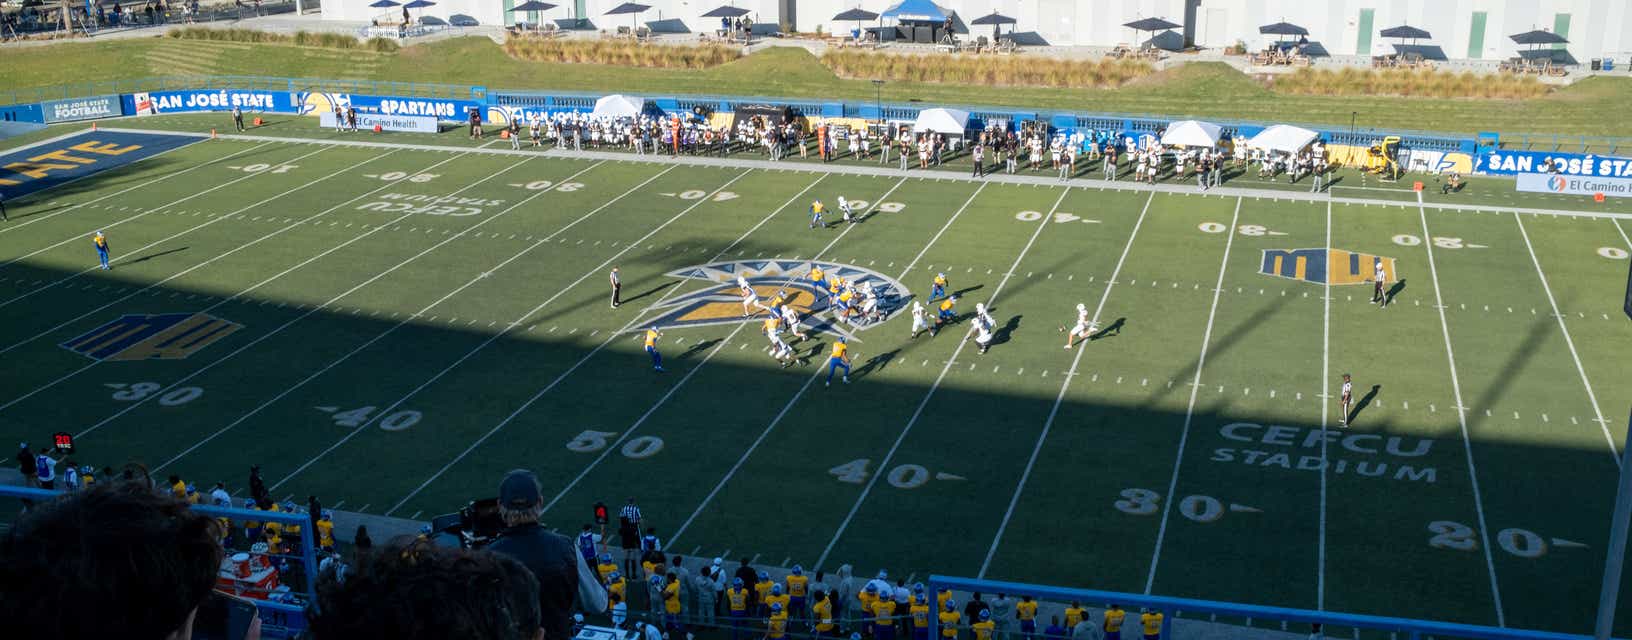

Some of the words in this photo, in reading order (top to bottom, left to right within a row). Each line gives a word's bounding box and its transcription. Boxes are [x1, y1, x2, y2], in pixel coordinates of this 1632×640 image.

[150, 94, 183, 109] SAN
[185, 89, 229, 107] JOSÉ
[231, 93, 274, 107] STATE
[380, 99, 455, 117] SPARTANS
[54, 105, 110, 118] FOOTBALL
[363, 116, 391, 127] Camino
[392, 118, 418, 129] Health
[1488, 154, 1533, 172] SAN
[1569, 180, 1581, 190] El
[1583, 181, 1625, 193] Camino
[1218, 421, 1436, 458] CEFCU
[1209, 448, 1437, 484] STADIUM
